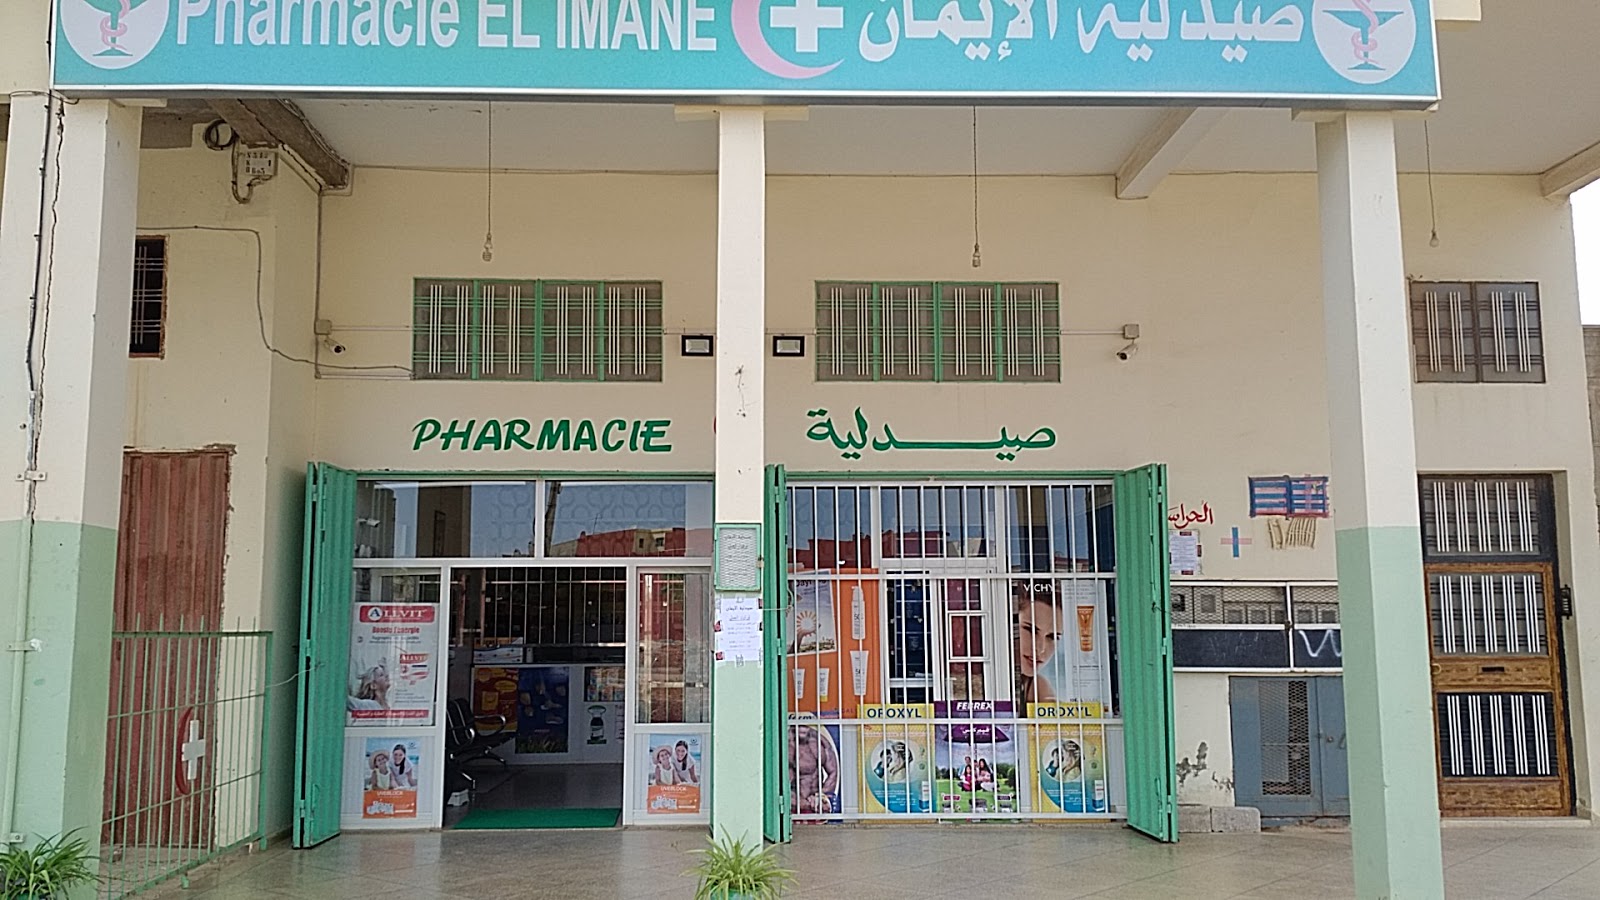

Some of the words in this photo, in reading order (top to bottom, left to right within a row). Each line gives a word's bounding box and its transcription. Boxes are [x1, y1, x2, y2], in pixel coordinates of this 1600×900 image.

[177, 0, 460, 48] Pharmacie
[478, 0, 540, 48] EL
[556, 0, 717, 51] IMANE
[412, 418, 673, 453] PHARMACIE
[806, 406, 1056, 462] صيدلية
[1023, 583, 1053, 592] VCHY
[369, 607, 427, 619] ALLVIT
